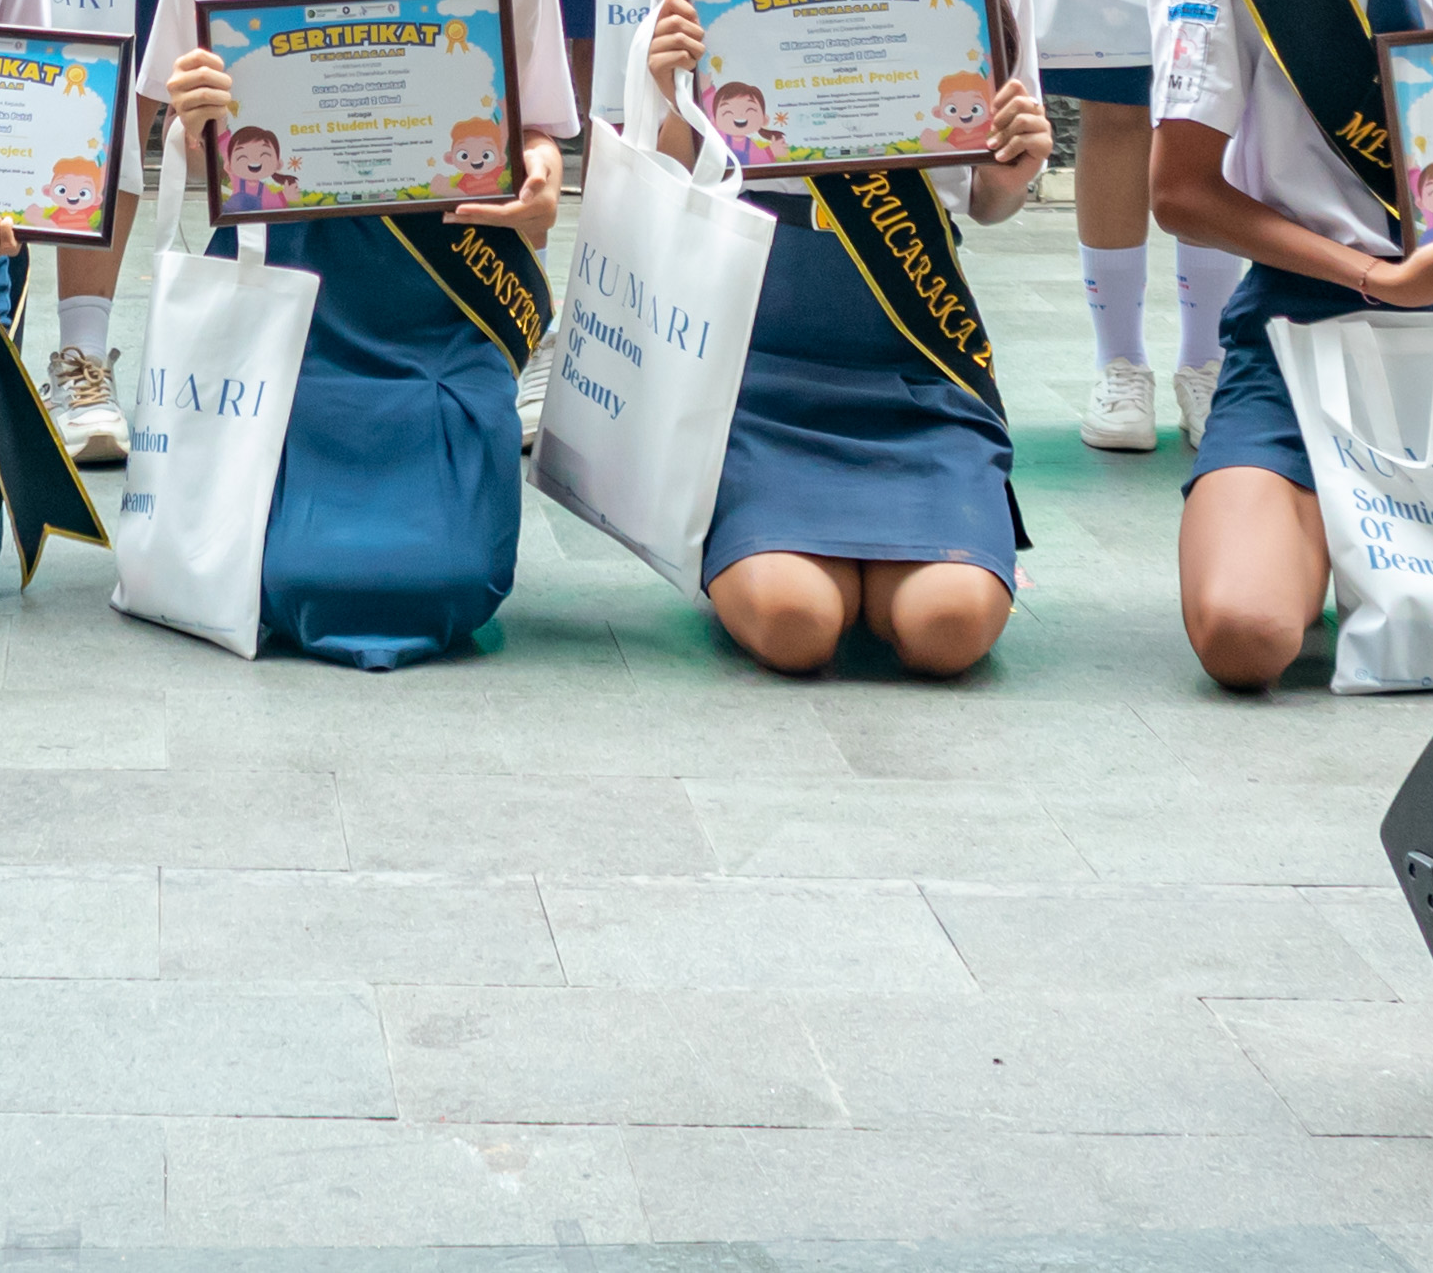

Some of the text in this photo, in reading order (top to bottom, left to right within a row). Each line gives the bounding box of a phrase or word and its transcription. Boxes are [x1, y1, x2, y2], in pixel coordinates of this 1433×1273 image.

[270, 22, 442, 57] SERTIFIKAT
[775, 70, 919, 90] Best Student Project
[290, 115, 433, 136] Best Student Project
[578, 242, 710, 359] KUMARI
[568, 328, 586, 358] Of
[572, 299, 643, 367] Solution
[560, 356, 627, 420] Beauty
[1361, 517, 1394, 542] Of
